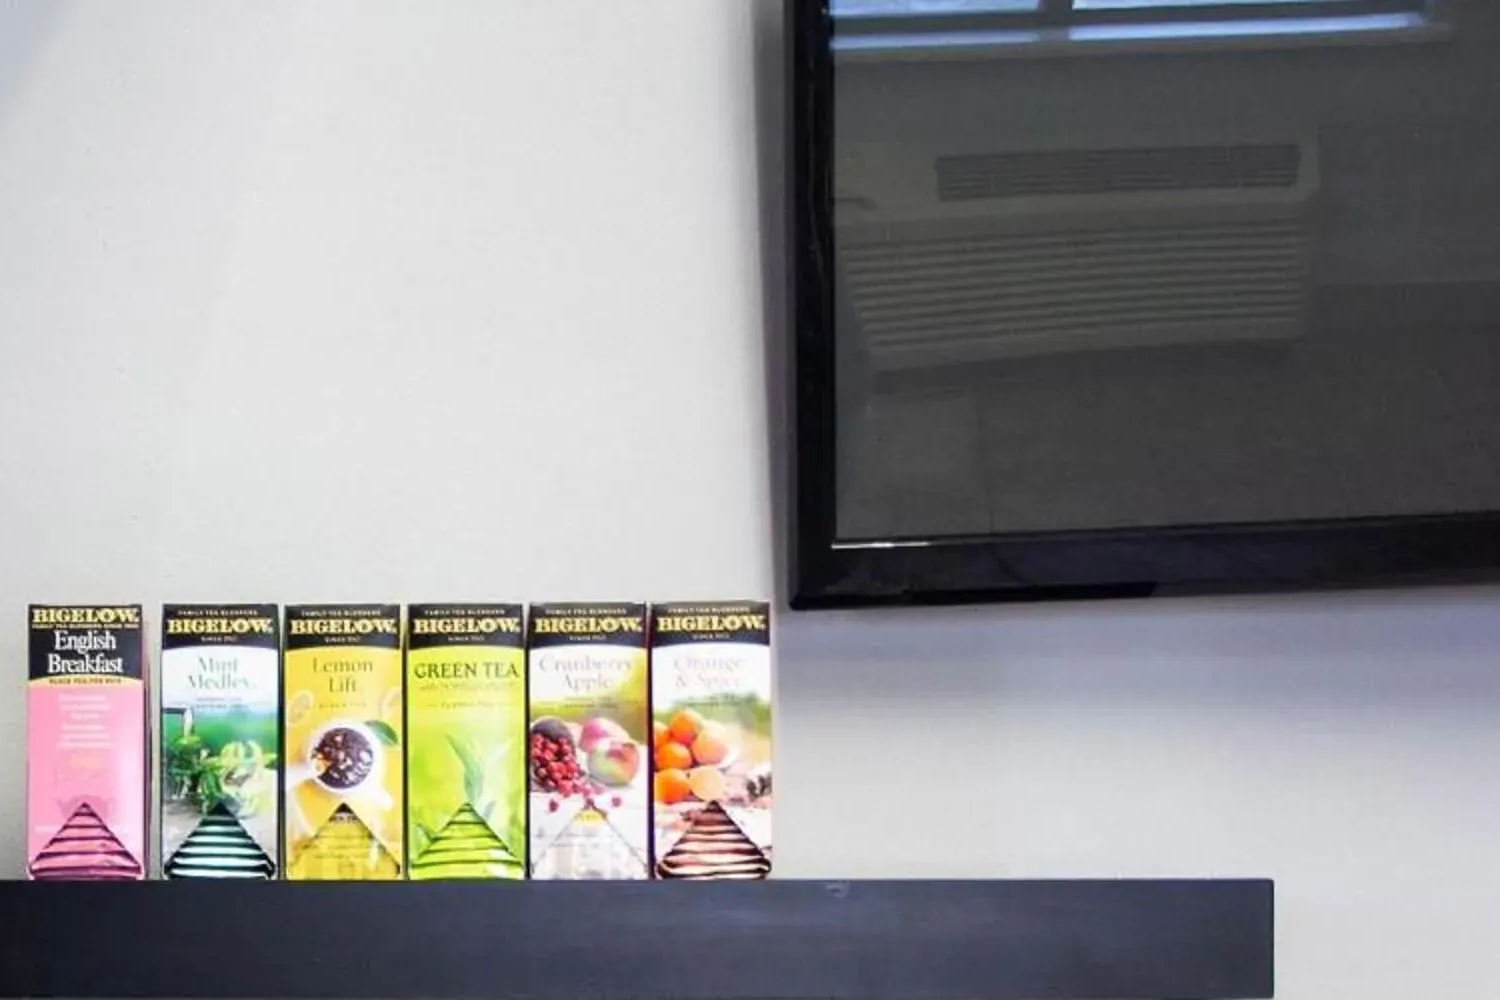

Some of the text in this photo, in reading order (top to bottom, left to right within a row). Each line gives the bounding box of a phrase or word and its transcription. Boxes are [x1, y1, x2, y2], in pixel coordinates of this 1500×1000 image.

[54, 629, 117, 655] English
[47, 653, 124, 673] Breakfast
[312, 657, 374, 673] Lemon
[413, 660, 520, 679] GREEN TEA
[328, 676, 357, 693] Lift
[564, 674, 614, 695] Apple
